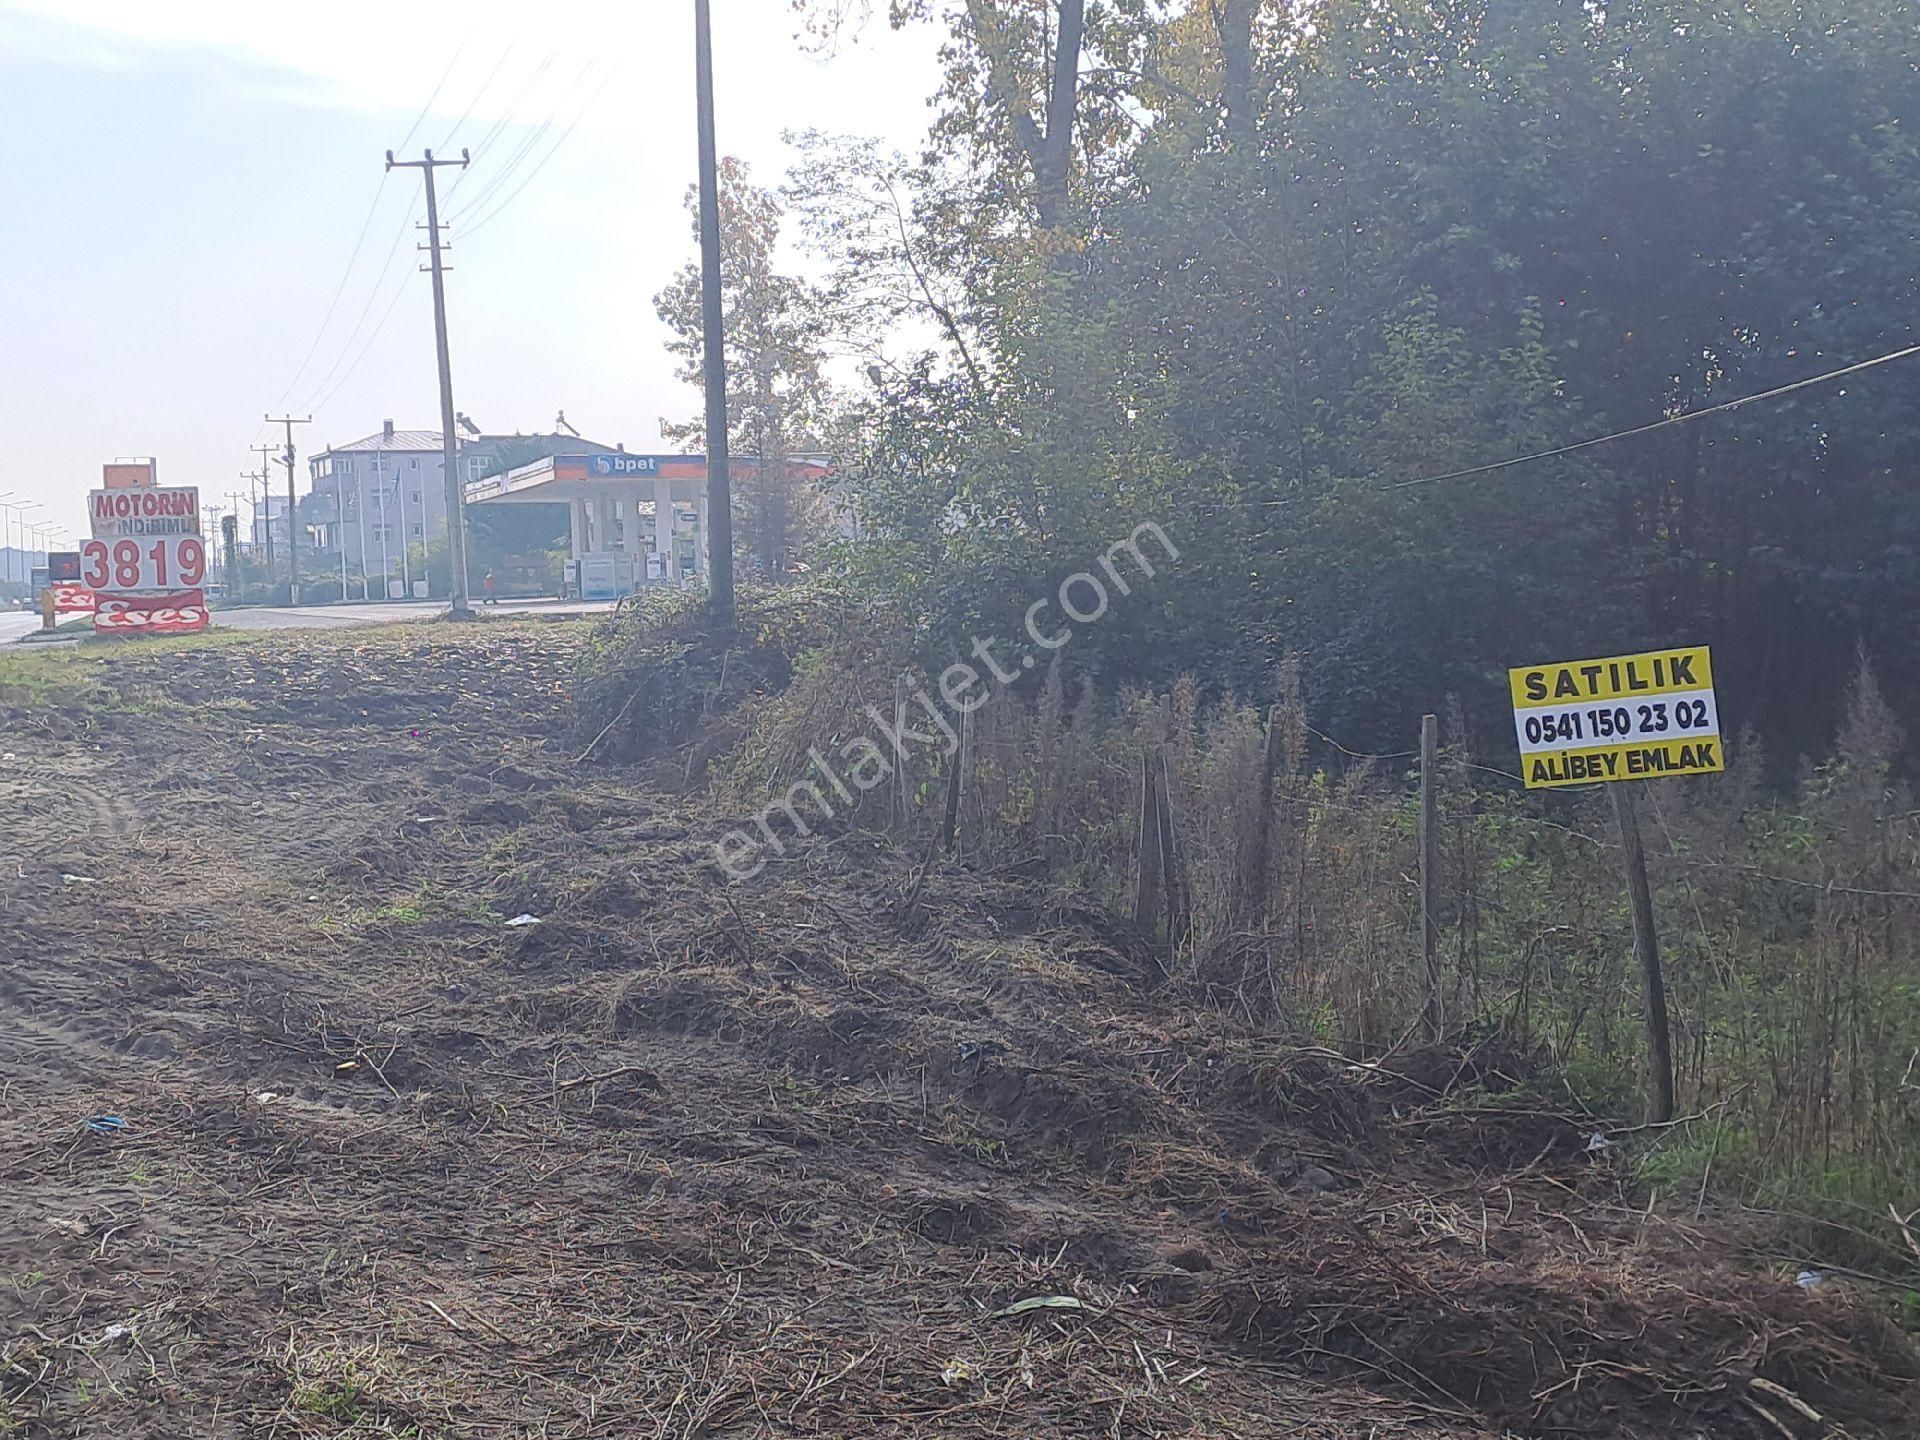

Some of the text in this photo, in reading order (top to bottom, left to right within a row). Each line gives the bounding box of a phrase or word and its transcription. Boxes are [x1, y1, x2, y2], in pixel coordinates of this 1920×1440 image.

[614, 457, 655, 472] bpet
[1525, 655, 1697, 700] SATILIK
[1525, 699, 1709, 744] 0541 150 23 02
[1531, 743, 1716, 782] ALİBEY EMLAK
